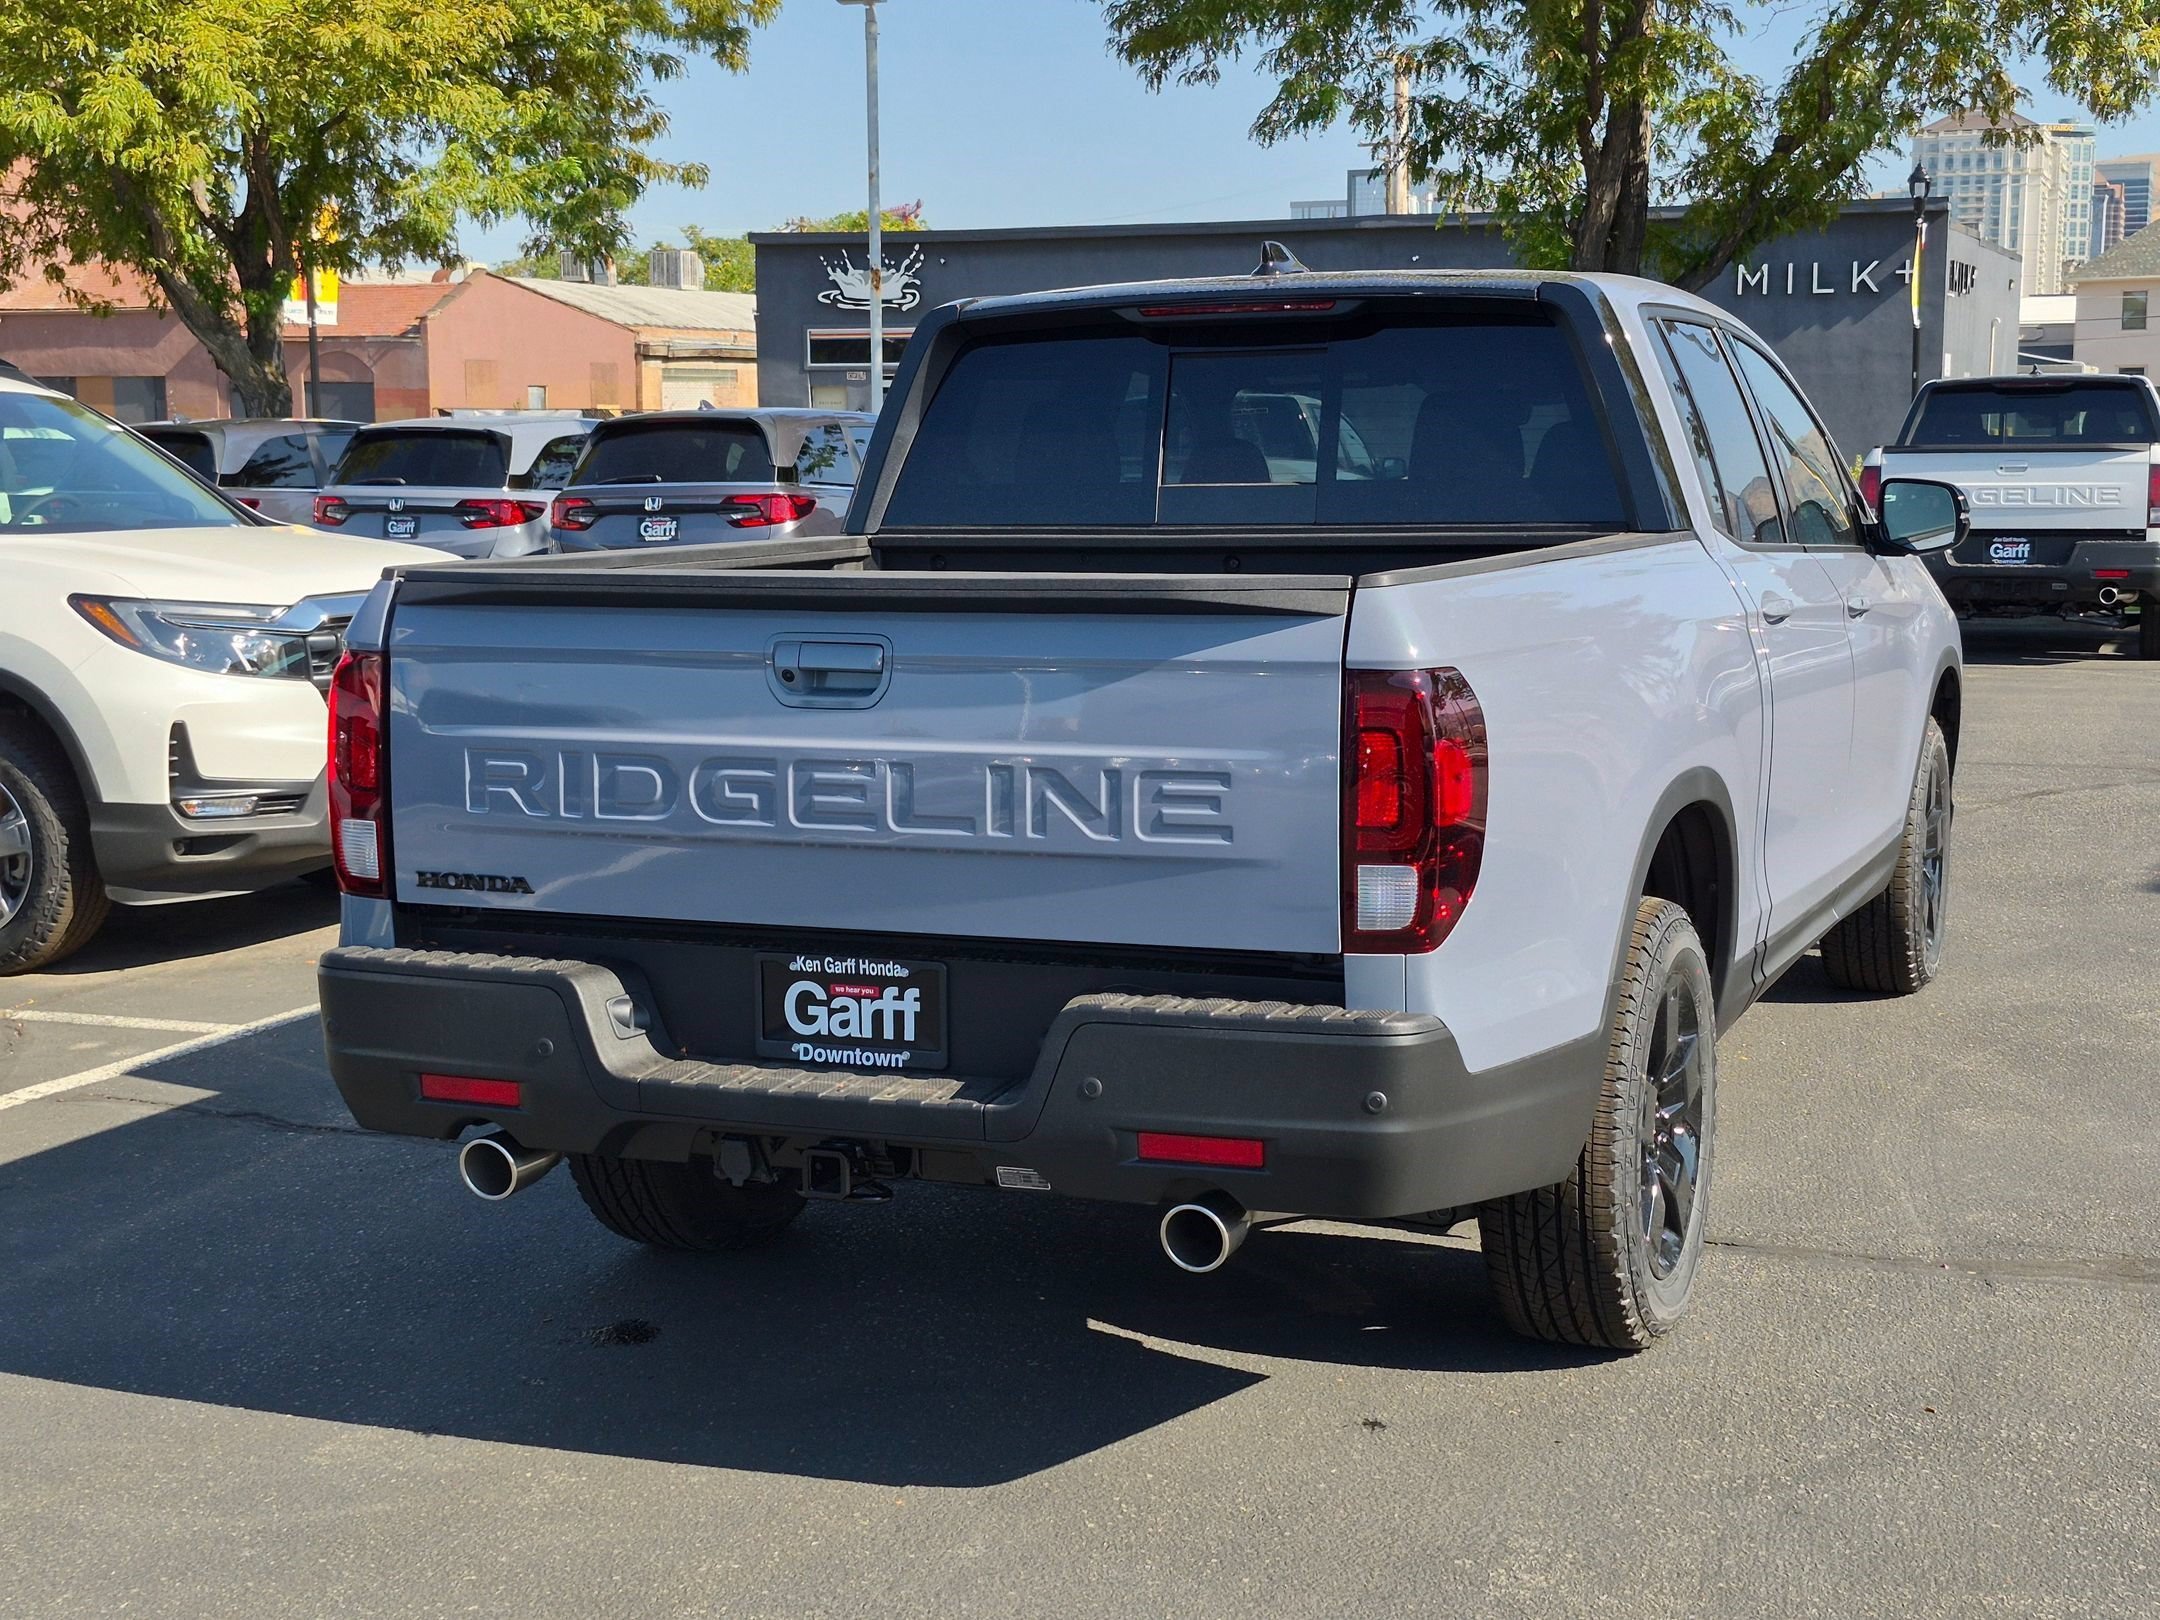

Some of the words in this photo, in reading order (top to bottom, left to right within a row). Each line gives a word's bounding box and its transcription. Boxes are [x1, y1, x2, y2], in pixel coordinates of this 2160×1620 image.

[388, 521, 415, 533] Garff
[640, 520, 677, 537] Garff
[1990, 543, 2030, 558] Garff
[464, 747, 1234, 845] RIDGELINE
[415, 870, 536, 894] HONDA
[796, 955, 821, 972] Ken
[824, 957, 856, 975] Garff
[859, 959, 901, 977] Honda
[846, 986, 860, 994] hear
[861, 988, 874, 996] you
[784, 980, 920, 1041] Garff
[799, 1043, 903, 1068] Downtown
